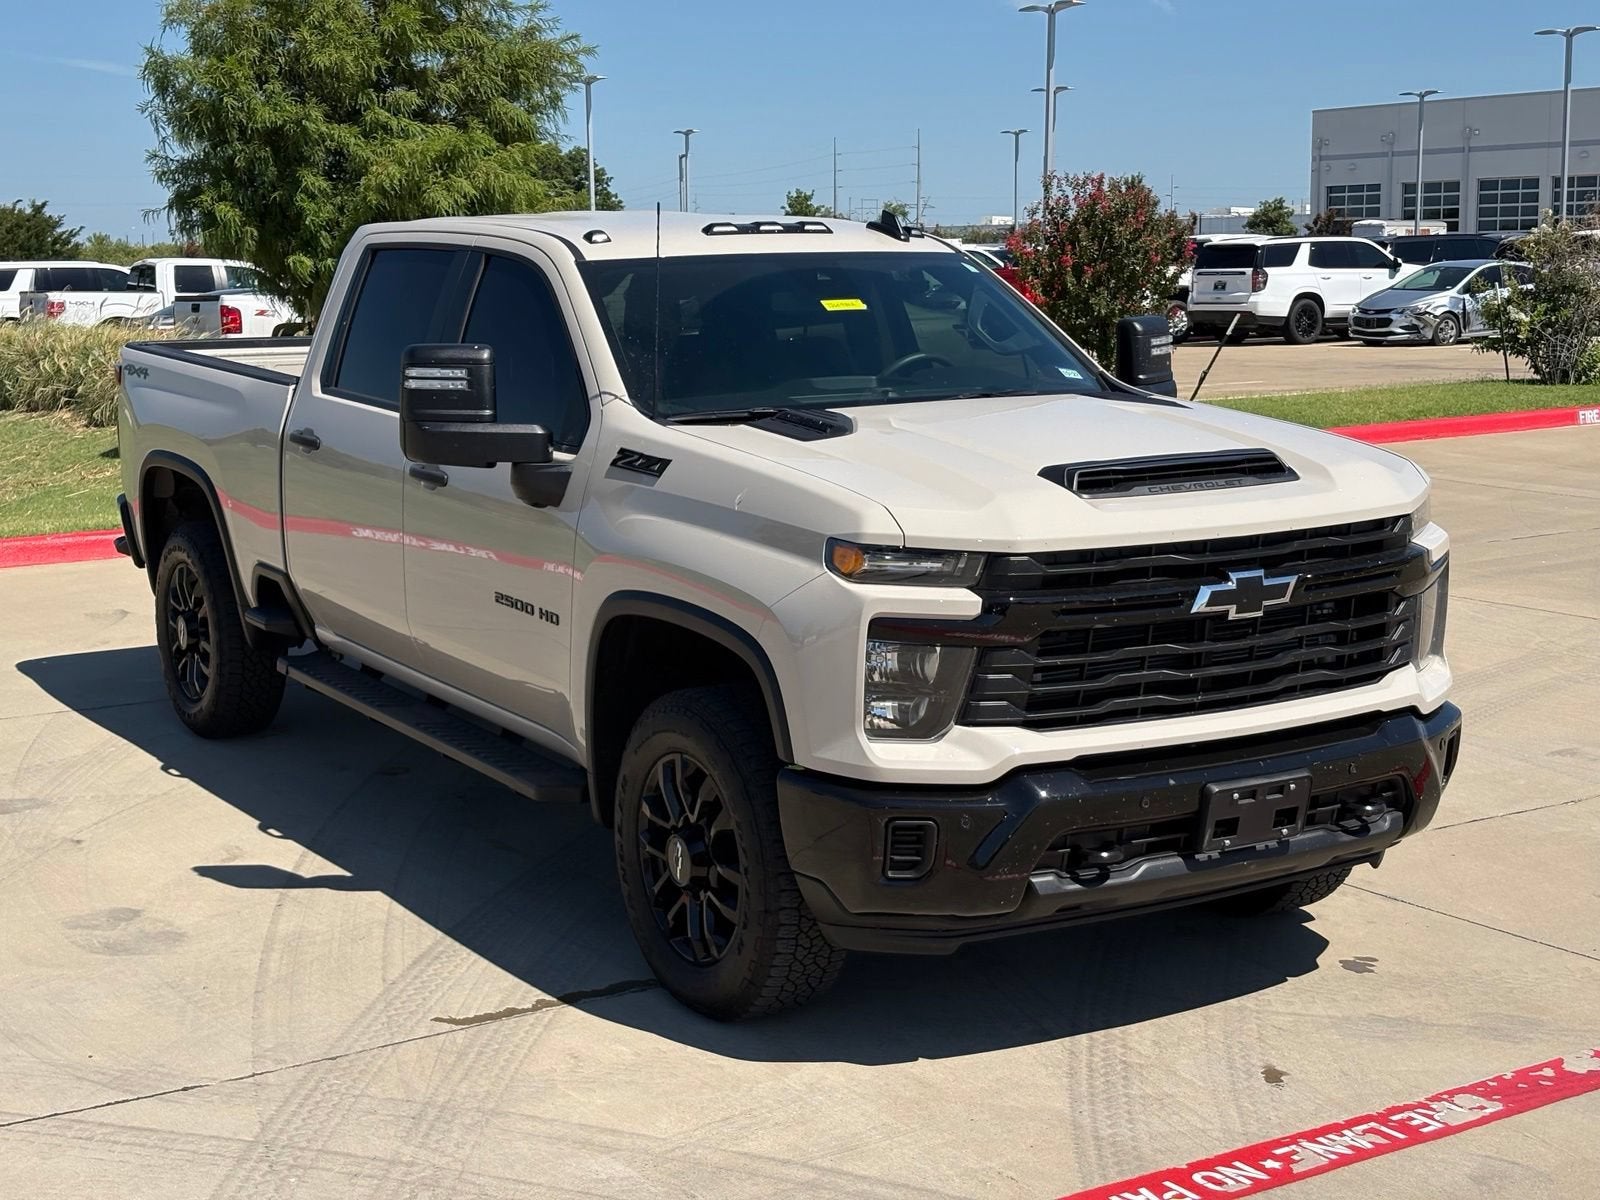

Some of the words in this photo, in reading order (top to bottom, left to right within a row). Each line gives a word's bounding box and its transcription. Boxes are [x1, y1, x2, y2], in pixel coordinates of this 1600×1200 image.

[1578, 409, 1600, 425] FIRE
[1147, 478, 1243, 493] CHEVROLET
[494, 591, 535, 616] 2500
[538, 606, 560, 626] HD
[1271, 1121, 1408, 1174] LANE
[1191, 1161, 1271, 1192] NO
